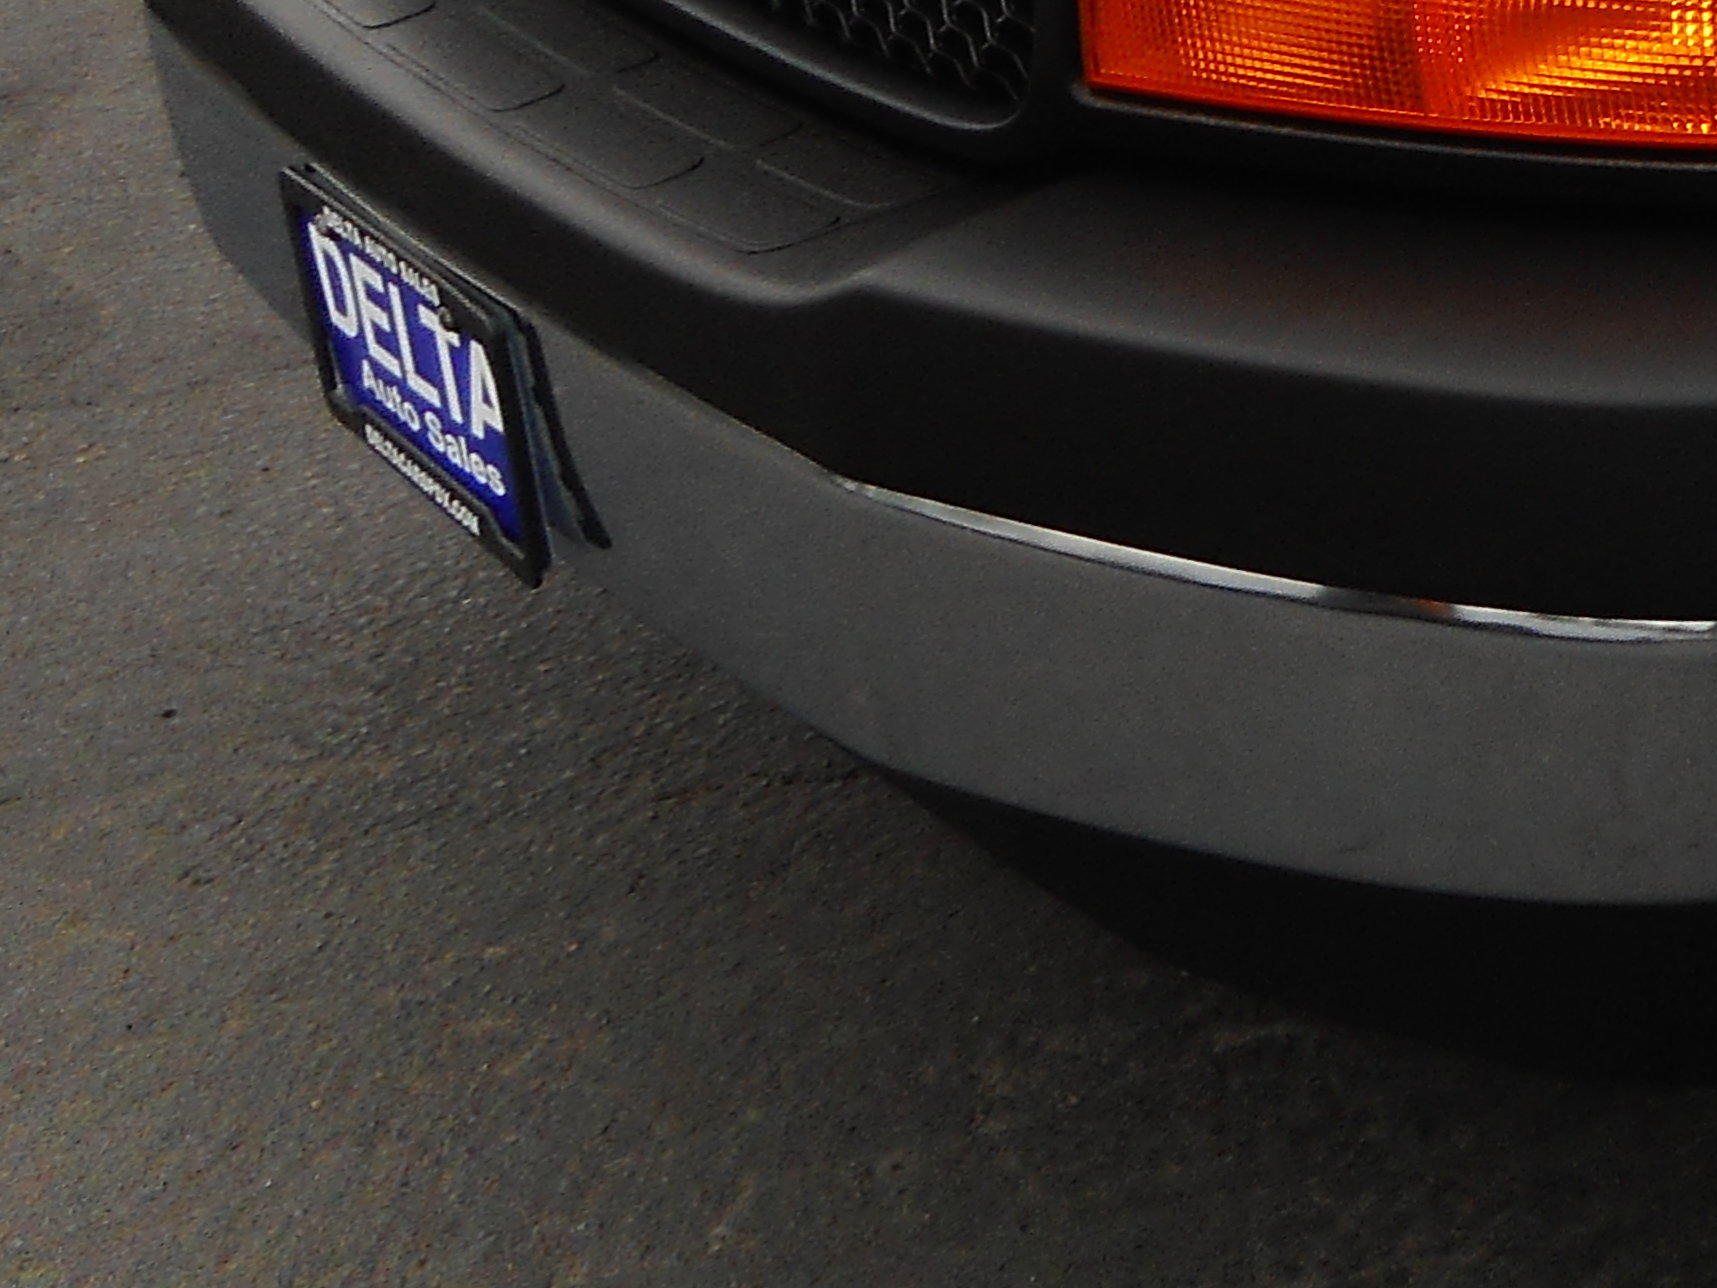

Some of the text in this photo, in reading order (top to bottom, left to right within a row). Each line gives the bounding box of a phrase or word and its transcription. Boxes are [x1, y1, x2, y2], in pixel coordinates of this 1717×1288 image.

[307, 221, 505, 440] DELTA
[361, 359, 507, 498] Auto Sales
